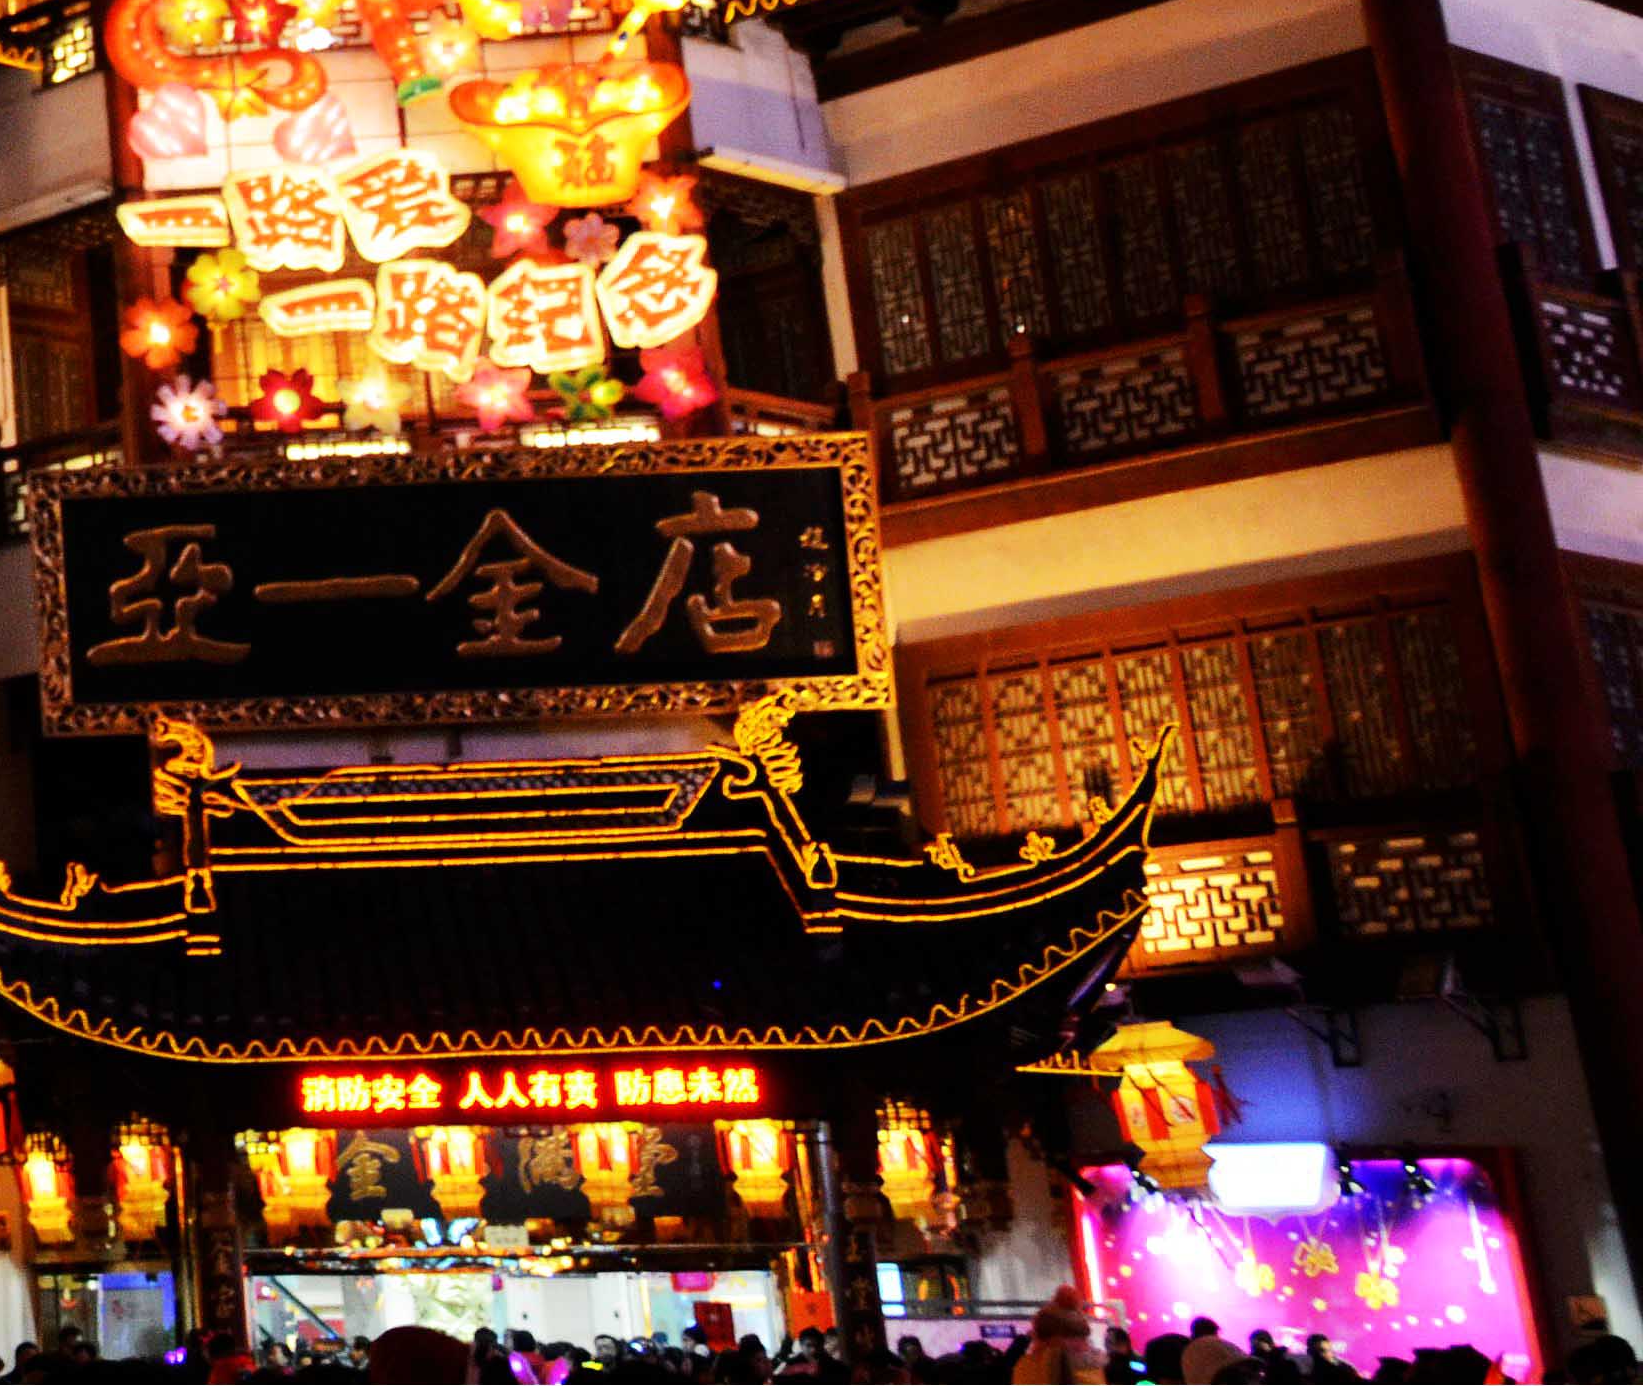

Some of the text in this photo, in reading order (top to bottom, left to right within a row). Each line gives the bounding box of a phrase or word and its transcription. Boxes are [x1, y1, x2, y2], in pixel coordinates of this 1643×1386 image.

[301, 1067, 759, 1113] 消防安全 人人有责 防患未然
